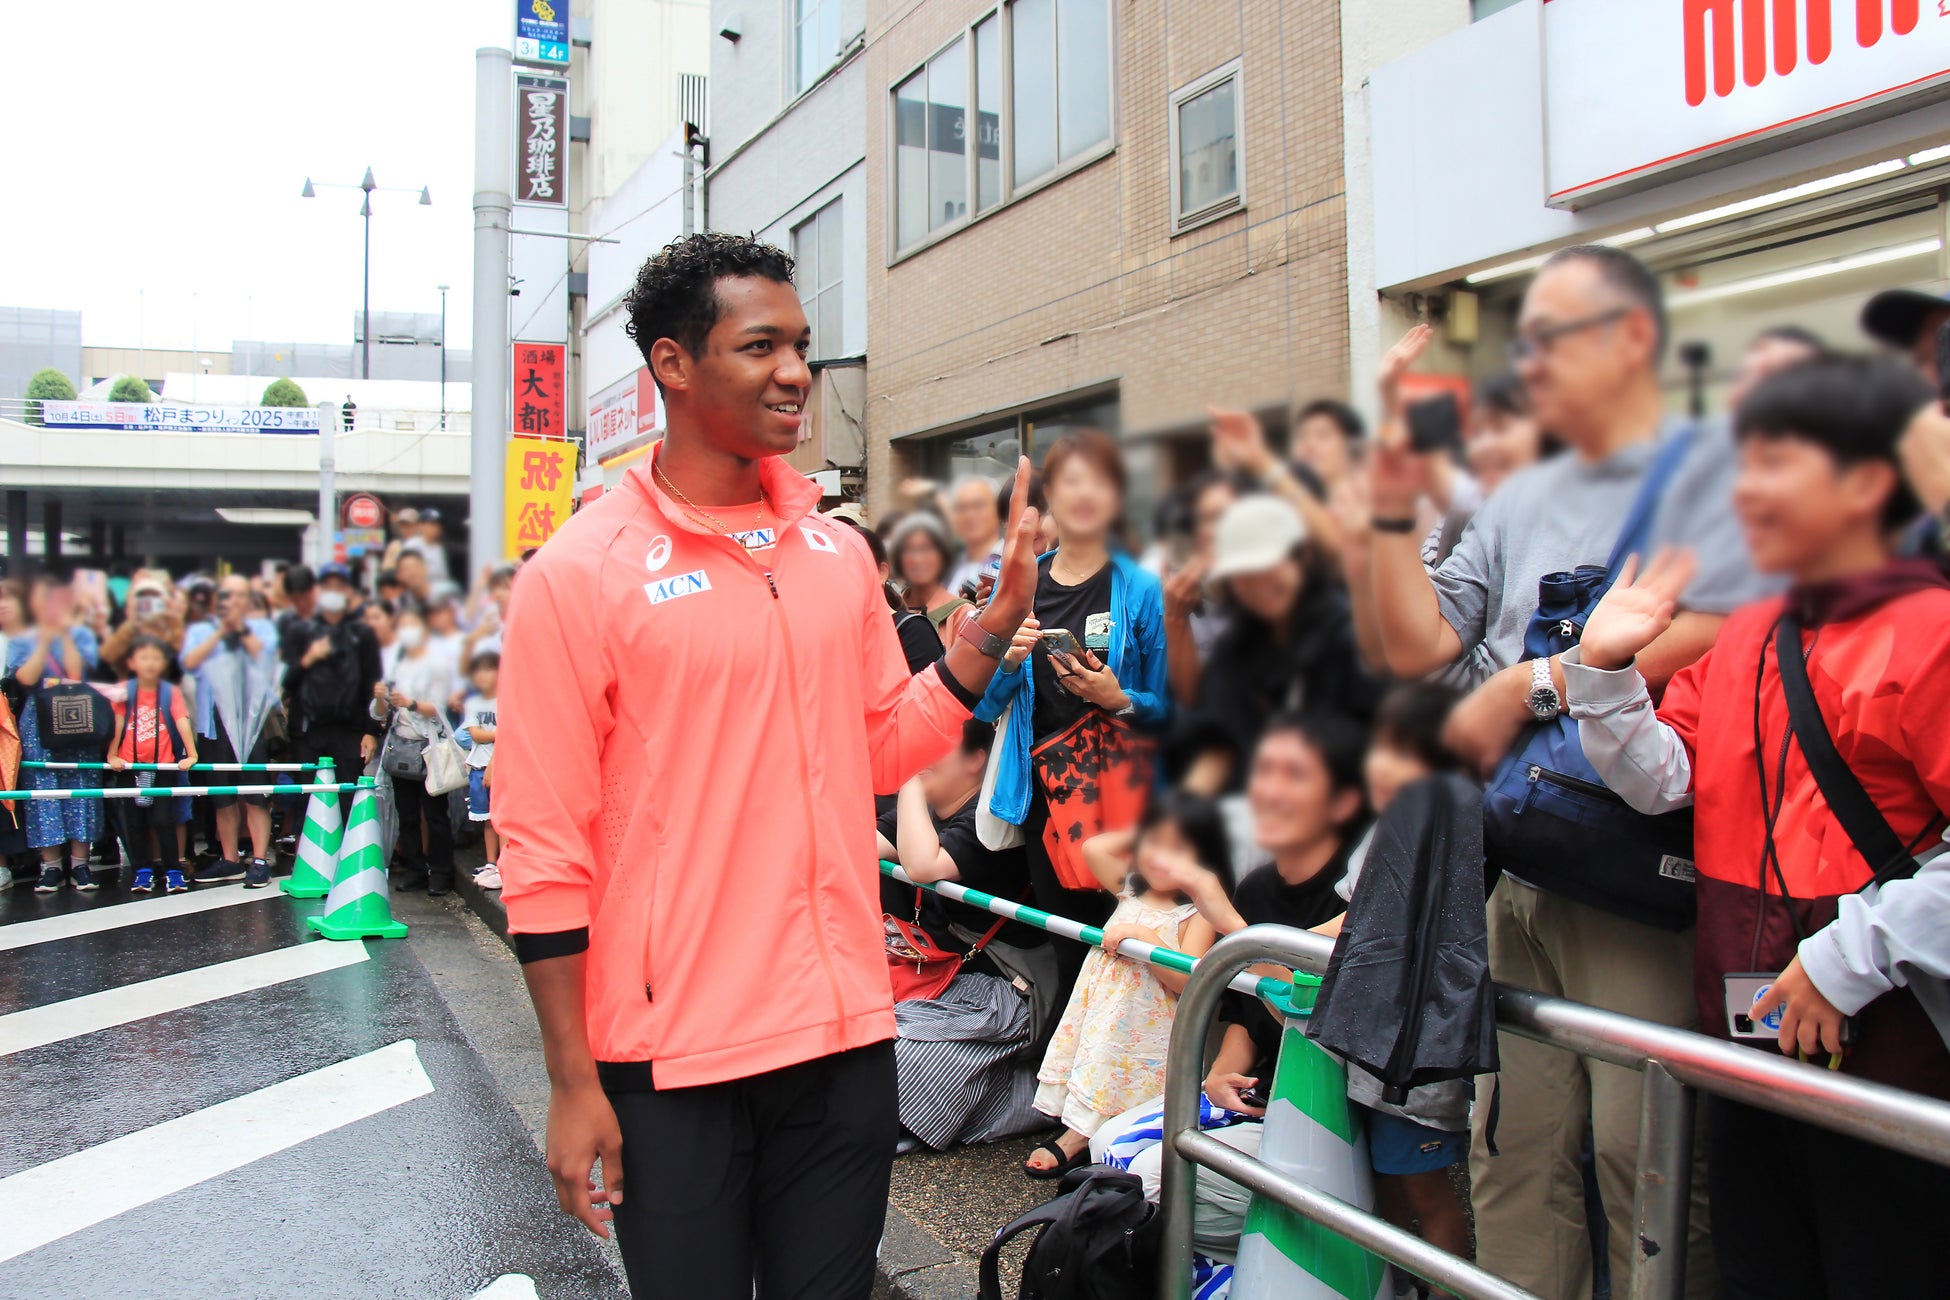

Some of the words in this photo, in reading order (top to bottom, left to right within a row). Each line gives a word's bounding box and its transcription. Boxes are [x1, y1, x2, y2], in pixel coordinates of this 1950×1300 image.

[526, 92, 557, 200] 星乃珈琲店
[523, 349, 556, 365] 酒場
[518, 368, 550, 434] 大都
[241, 410, 283, 427] 2025
[654, 572, 703, 602] ACN
